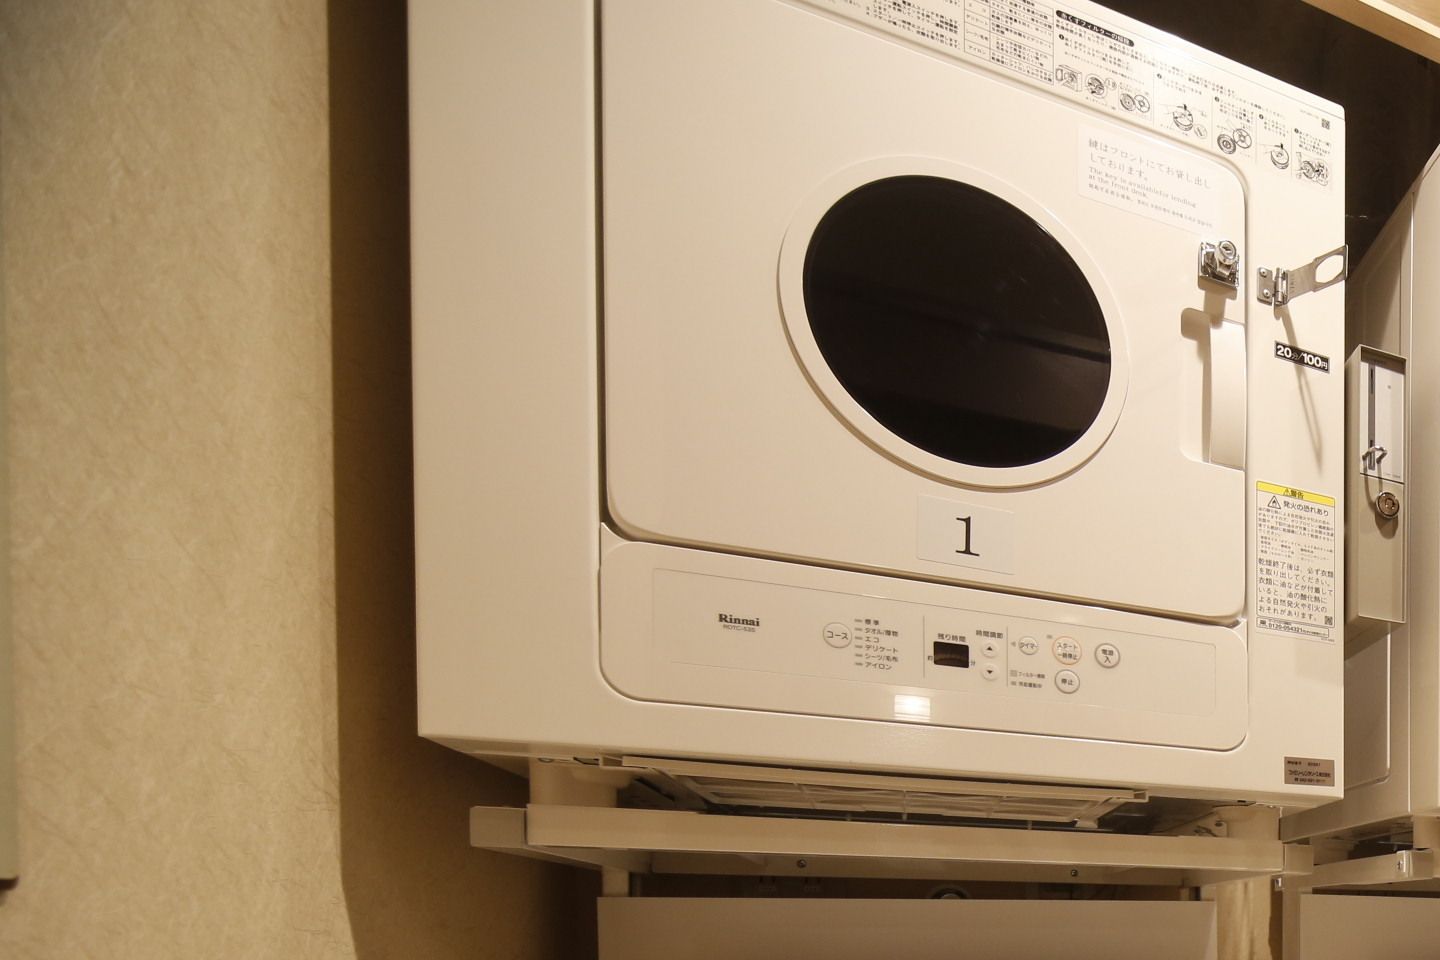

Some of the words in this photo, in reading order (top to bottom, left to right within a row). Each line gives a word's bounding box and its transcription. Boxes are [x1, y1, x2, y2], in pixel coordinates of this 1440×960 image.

[1088, 138, 1211, 189] 鍵はフロントにてお貸し出し
[1090, 152, 1148, 181] しております。
[1276, 344, 1328, 370] 20分/100円
[1291, 489, 1305, 499] 警告
[1283, 500, 1329, 517] 発火の恐れあり
[955, 515, 980, 557] 1
[1259, 568, 1331, 587] を取り出してください。
[1258, 577, 1334, 596] 衣類に油などが付着して
[1258, 596, 1328, 613] よる自然発火や引火の
[718, 613, 760, 627] Rinnai
[1258, 606, 1317, 621] おそれがあります。
[827, 630, 849, 640] コース
[937, 632, 966, 643] 残り時間
[865, 644, 899, 654] デリケート
[1101, 648, 1114, 657] 電源
[865, 653, 899, 663] シーツ/毛布
[1104, 656, 1111, 664] 入
[865, 661, 893, 671] アイロン
[1061, 678, 1074, 686] 停止
